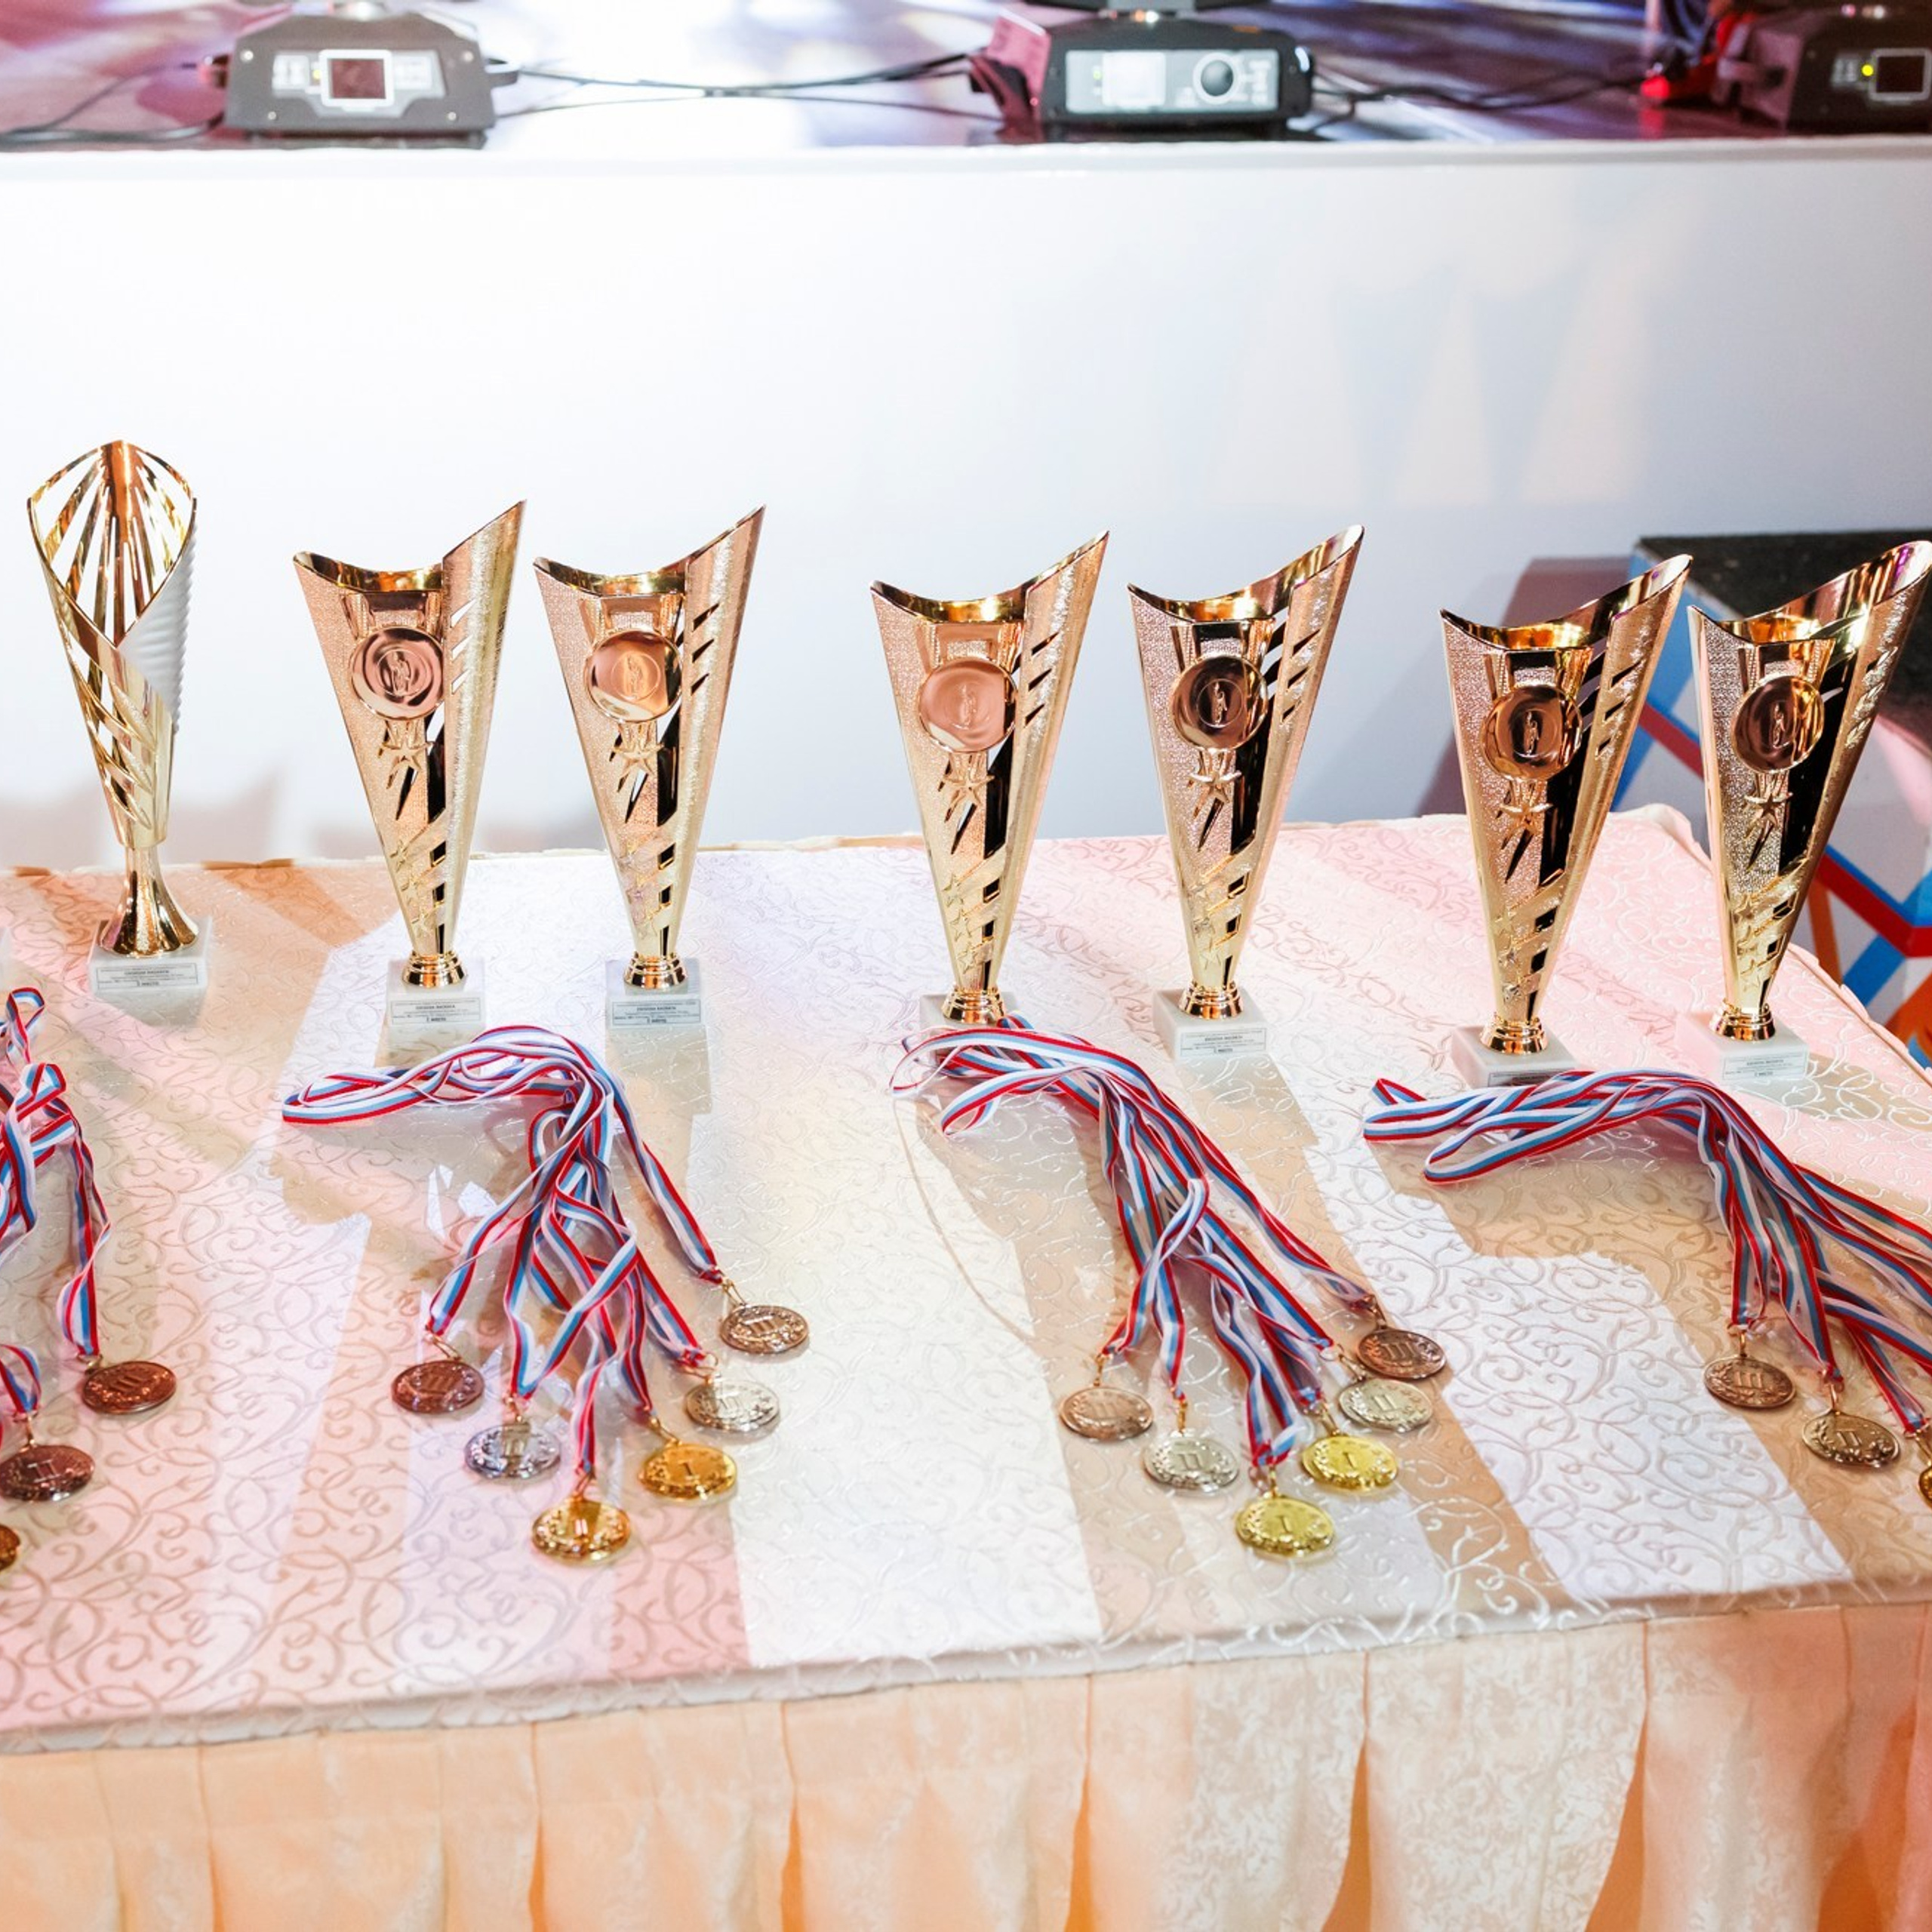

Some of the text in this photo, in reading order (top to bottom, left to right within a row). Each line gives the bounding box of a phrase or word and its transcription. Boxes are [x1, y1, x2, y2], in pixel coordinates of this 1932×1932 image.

[1380, 1342, 1417, 1359] III
[1733, 1371, 1764, 1389] III
[1371, 1394, 1397, 1413] II
[1835, 1428, 1863, 1447] II
[27, 1459, 62, 1483] II
[1178, 1453, 1204, 1472] II
